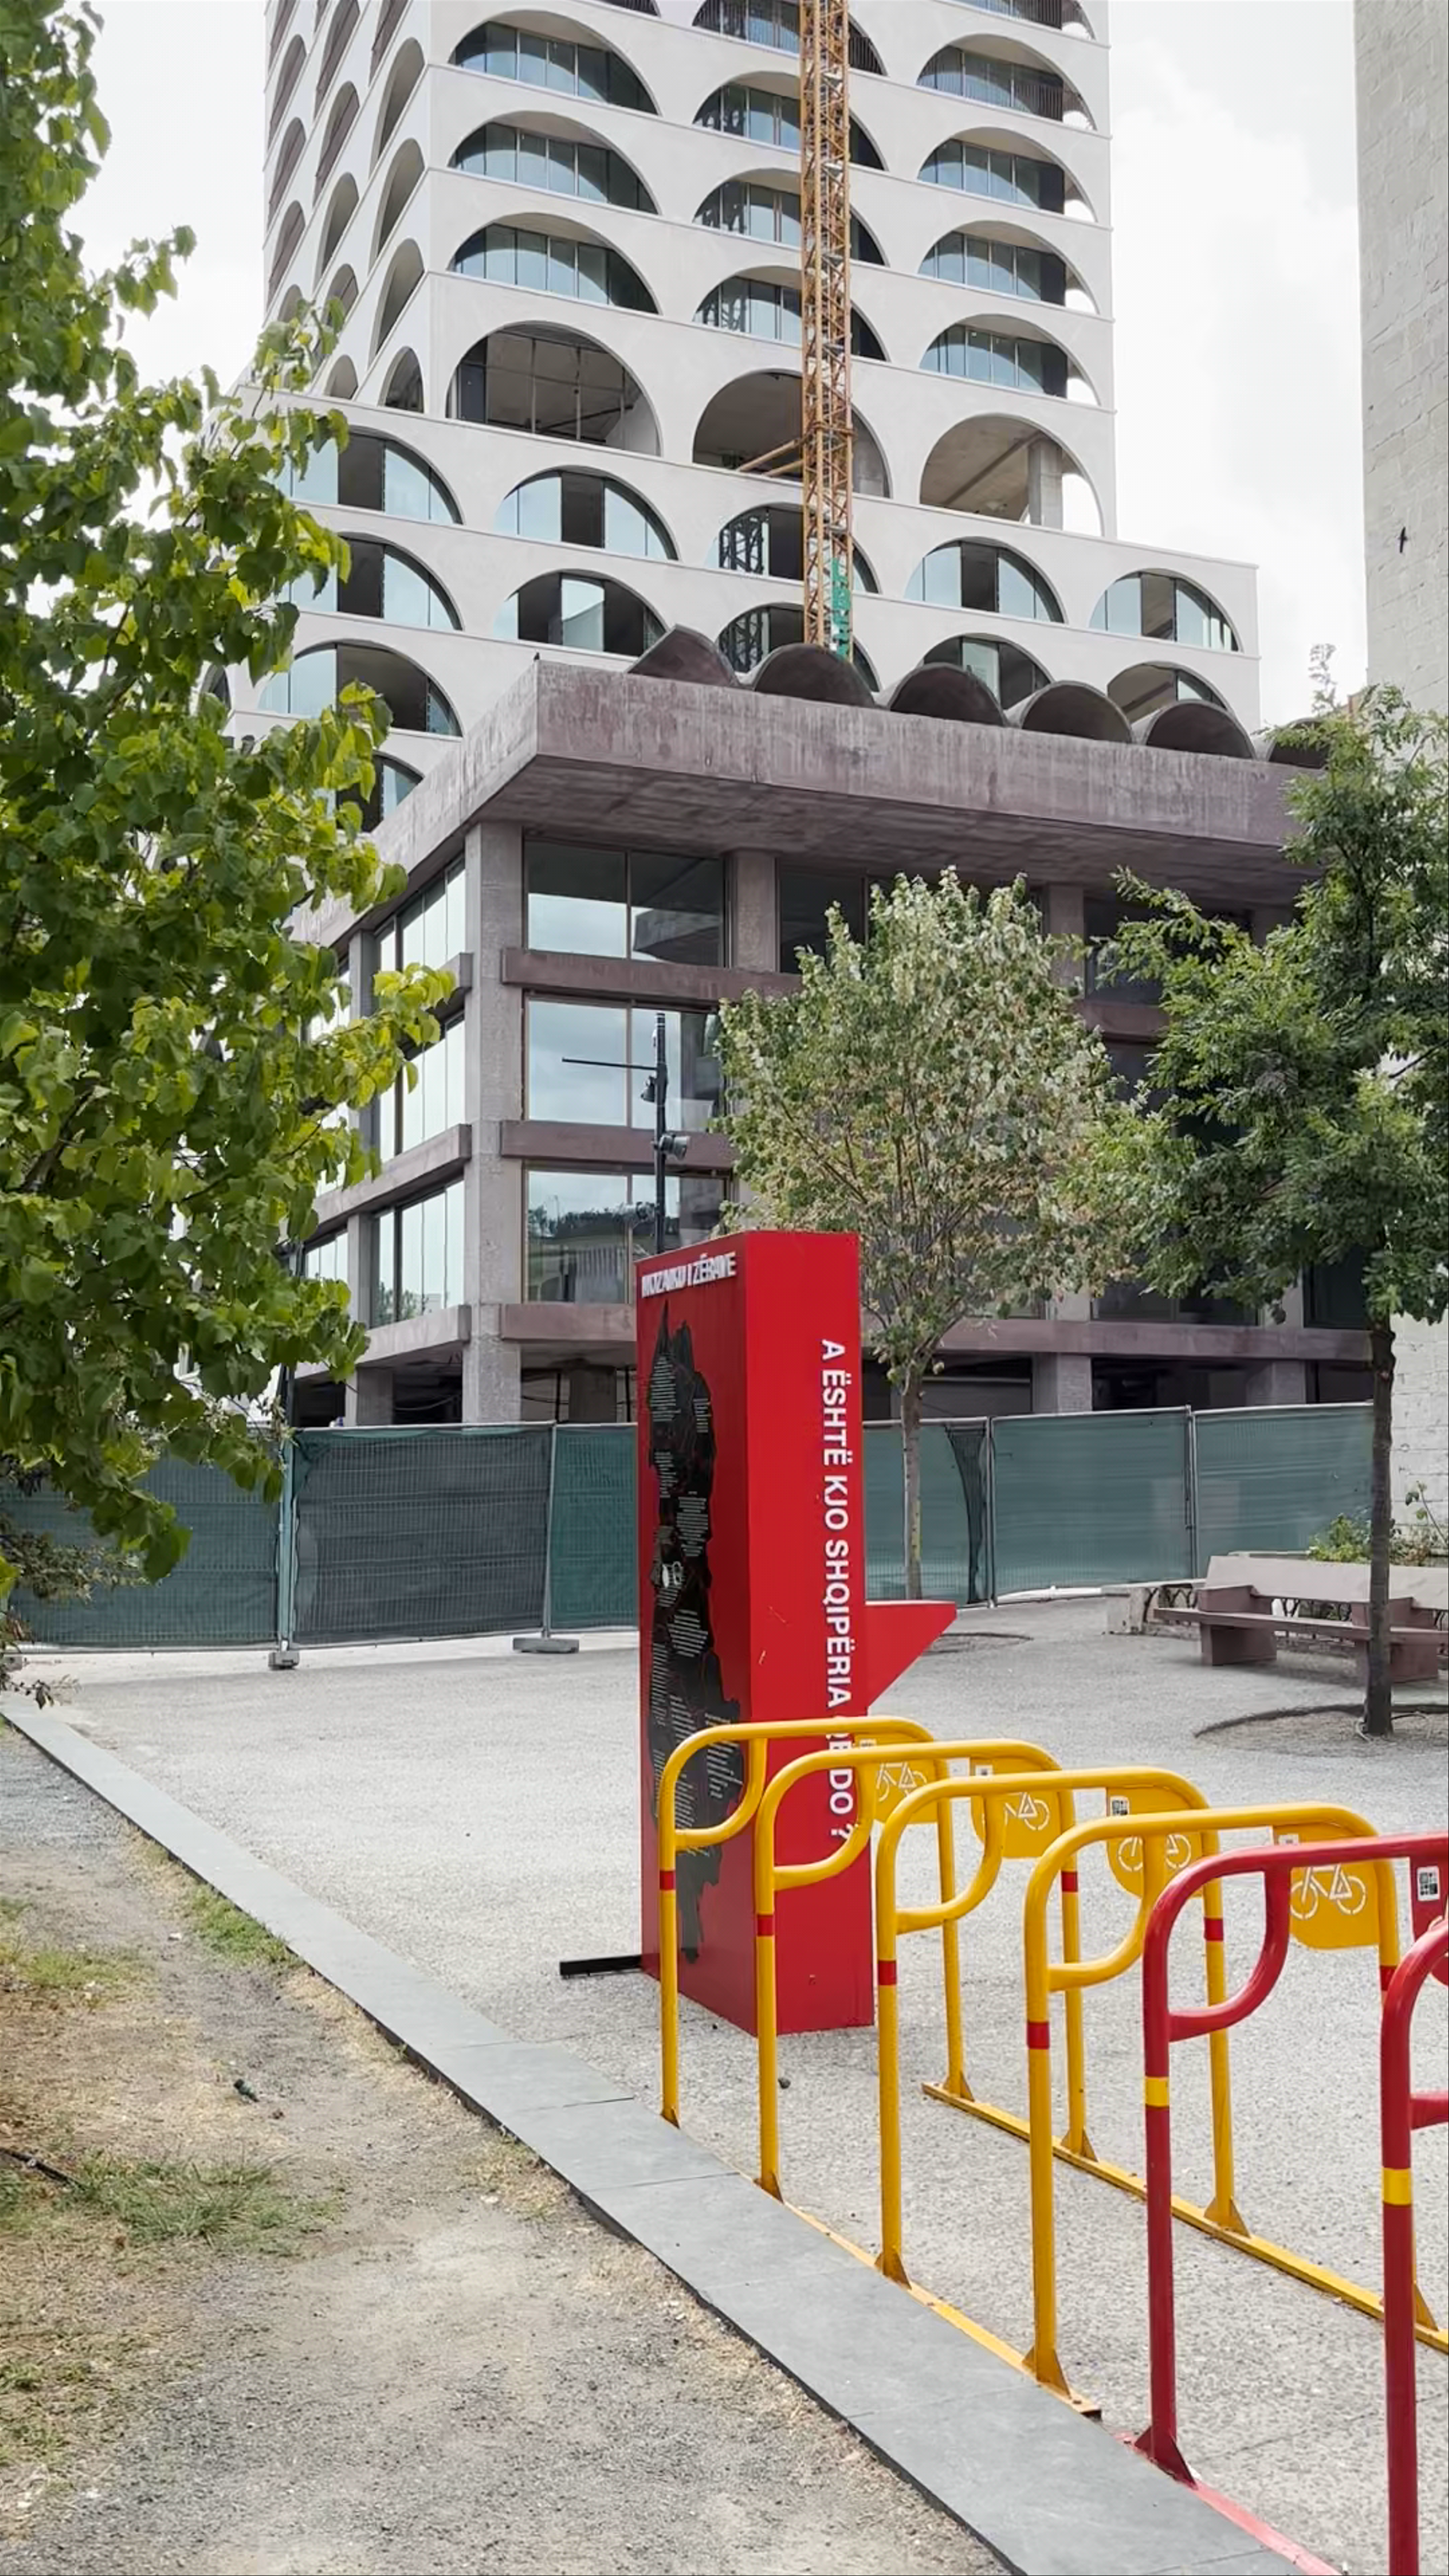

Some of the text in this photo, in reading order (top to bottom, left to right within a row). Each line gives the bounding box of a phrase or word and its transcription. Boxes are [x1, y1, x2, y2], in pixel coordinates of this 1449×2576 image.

[688, 1263, 692, 1287] I
[822, 1339, 846, 1360] A
[822, 1370, 852, 1465] ËSHTË
[824, 1475, 849, 1530] KJO
[823, 1539, 855, 1707] SHQIPËRIA
[830, 1769, 853, 1814] DO
